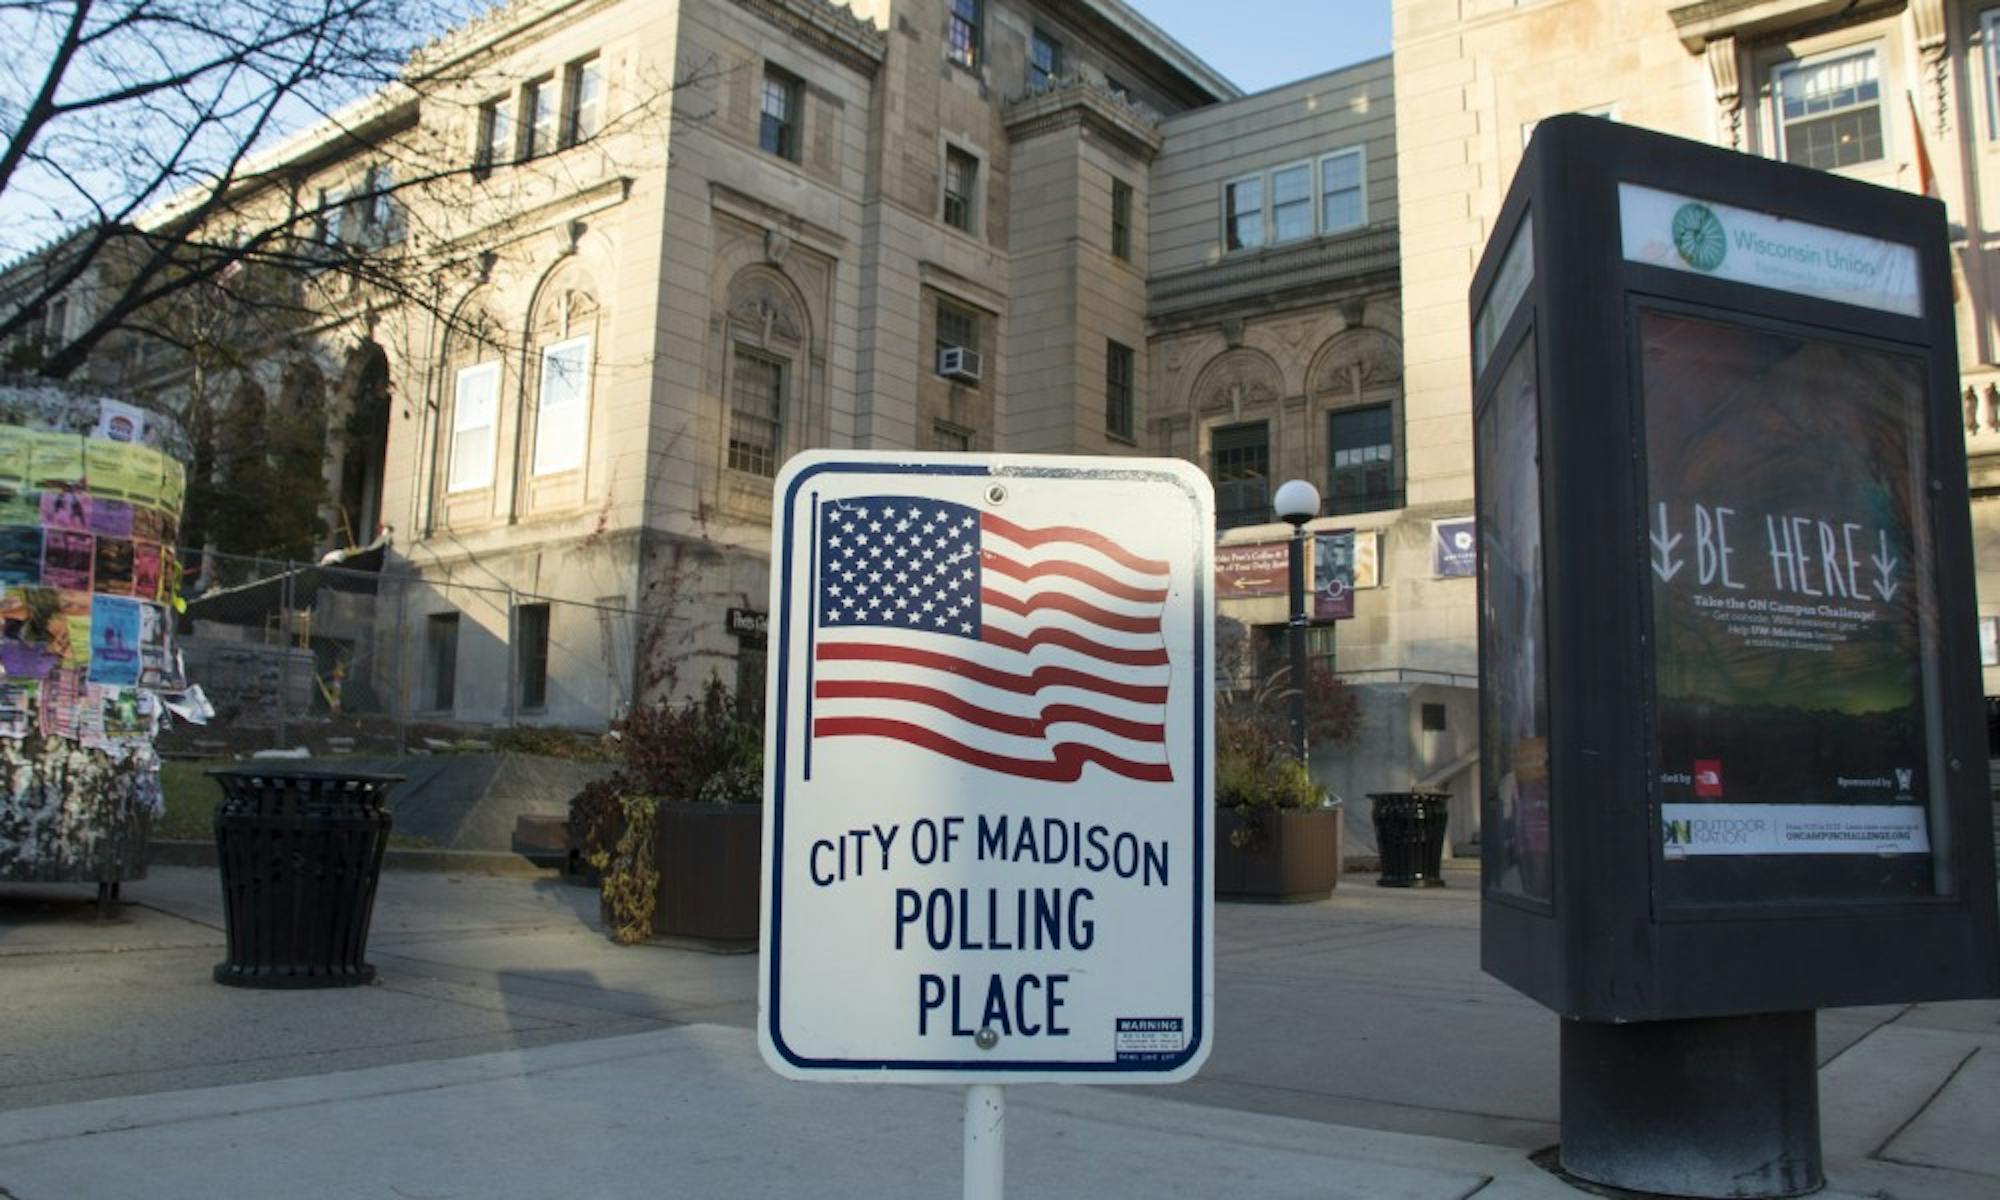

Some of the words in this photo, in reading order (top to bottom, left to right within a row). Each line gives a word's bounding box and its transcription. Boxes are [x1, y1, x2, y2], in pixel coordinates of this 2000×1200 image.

[1734, 229, 1821, 264] Wisconsin
[1825, 248, 1876, 275] Union
[1695, 503, 1745, 589] BE
[1766, 514, 1872, 600] HERE
[1693, 595, 1724, 608] Take
[1726, 597, 1745, 609] the
[1748, 599, 1767, 610] ON
[1769, 601, 1816, 616] Campus
[1817, 605, 1875, 622] Challenge!
[1694, 819, 1765, 832] OUTDOOR
[1694, 831, 1746, 844] NATION
[810, 824, 899, 886] CITY
[912, 817, 964, 865] OF
[977, 814, 1169, 886] MADISON
[895, 888, 1094, 950] POLLING
[919, 974, 1069, 1036] PLACE
[1121, 1020, 1178, 1031] WARNING
